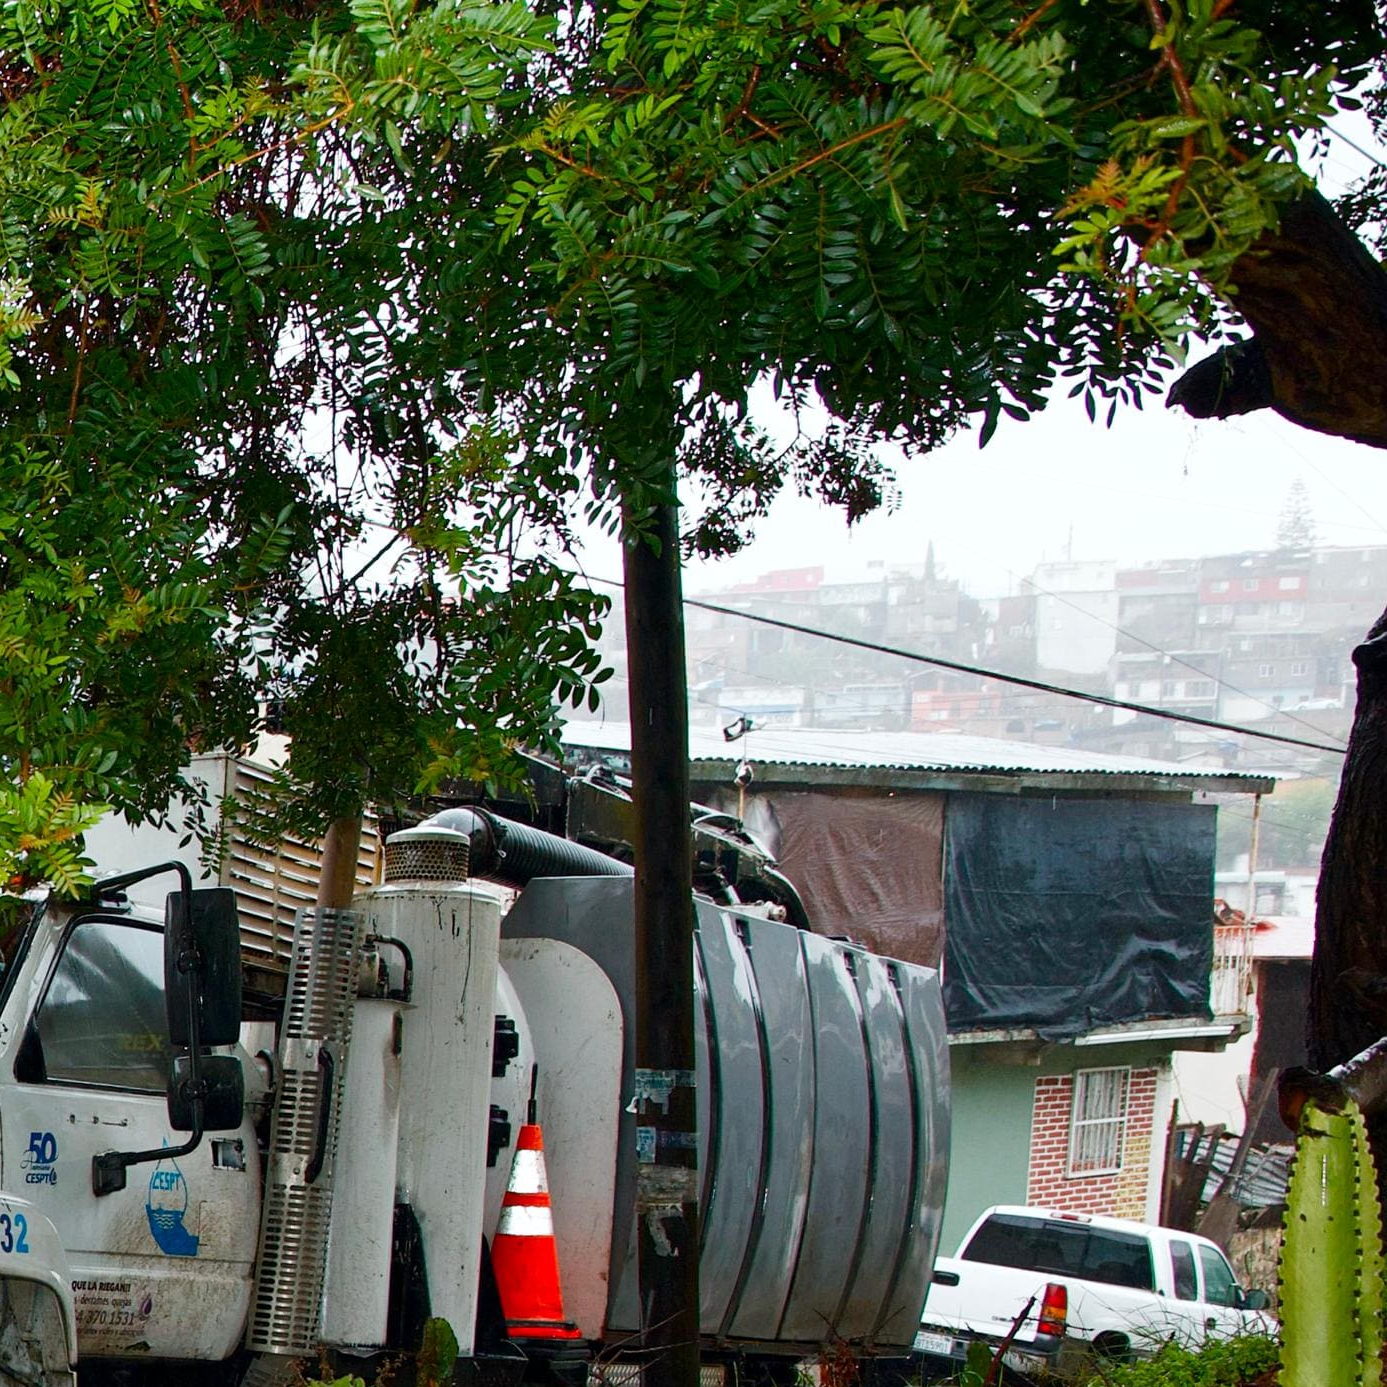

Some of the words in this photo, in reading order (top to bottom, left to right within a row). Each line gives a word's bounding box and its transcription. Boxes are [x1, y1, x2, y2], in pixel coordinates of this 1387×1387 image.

[29, 1131, 57, 1163] 50
[25, 1172, 50, 1184] CESPT
[152, 1171, 182, 1191] CESPT
[72, 1281, 86, 1291] QUE
[88, 1281, 97, 1290] LA
[108, 1311, 135, 1326] 1531
